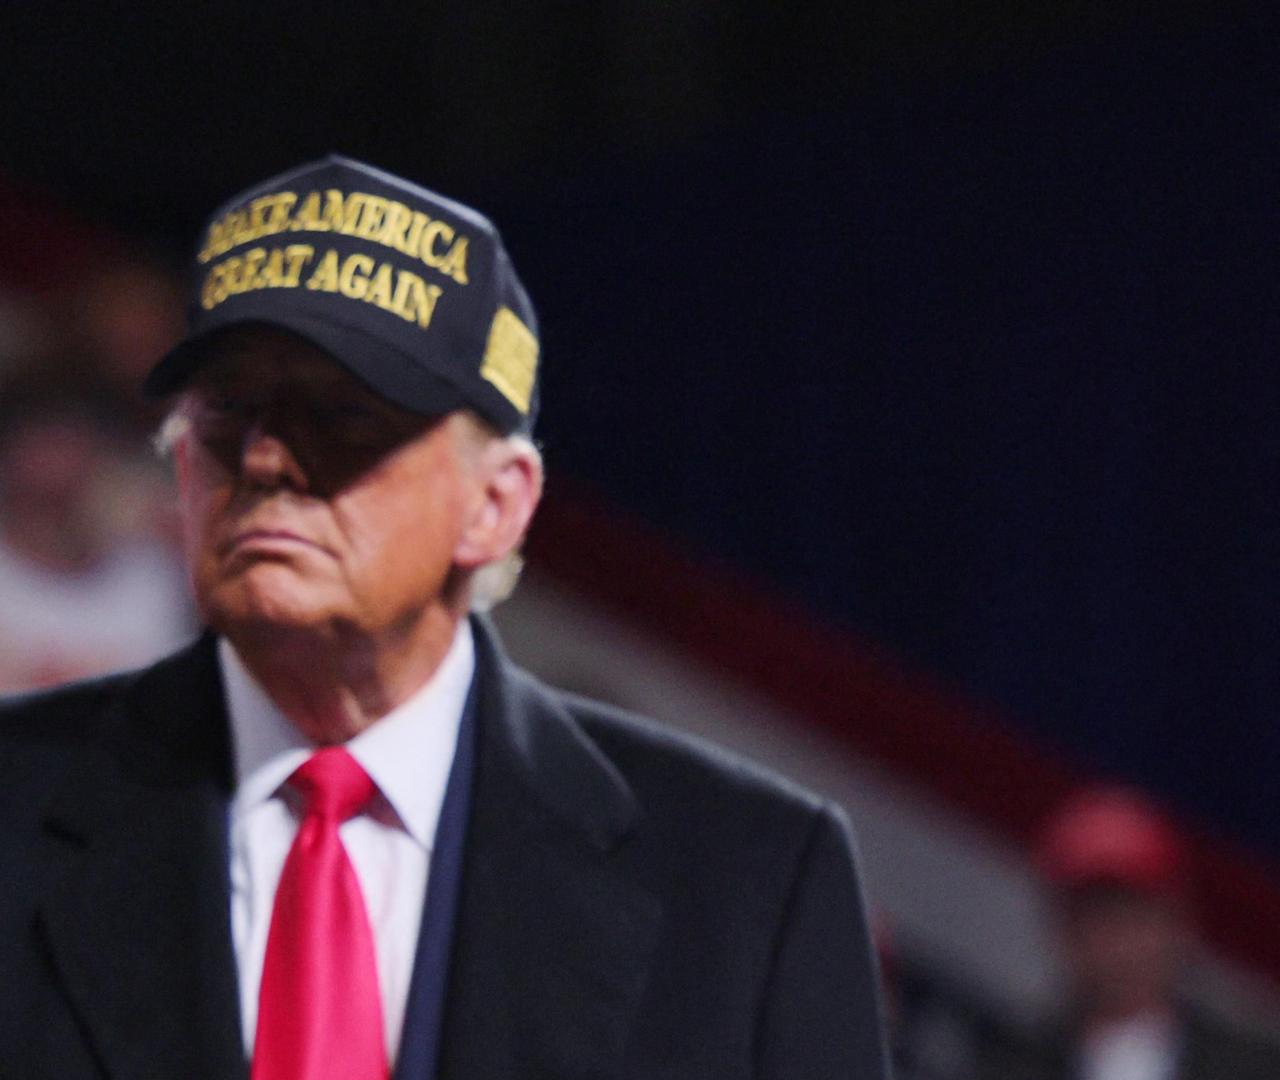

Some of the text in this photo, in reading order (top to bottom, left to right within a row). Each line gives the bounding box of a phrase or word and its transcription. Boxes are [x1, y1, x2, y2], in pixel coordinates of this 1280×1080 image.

[197, 188, 469, 285] MAKE AMERICA
[201, 244, 443, 331] GREAT AGAIN
